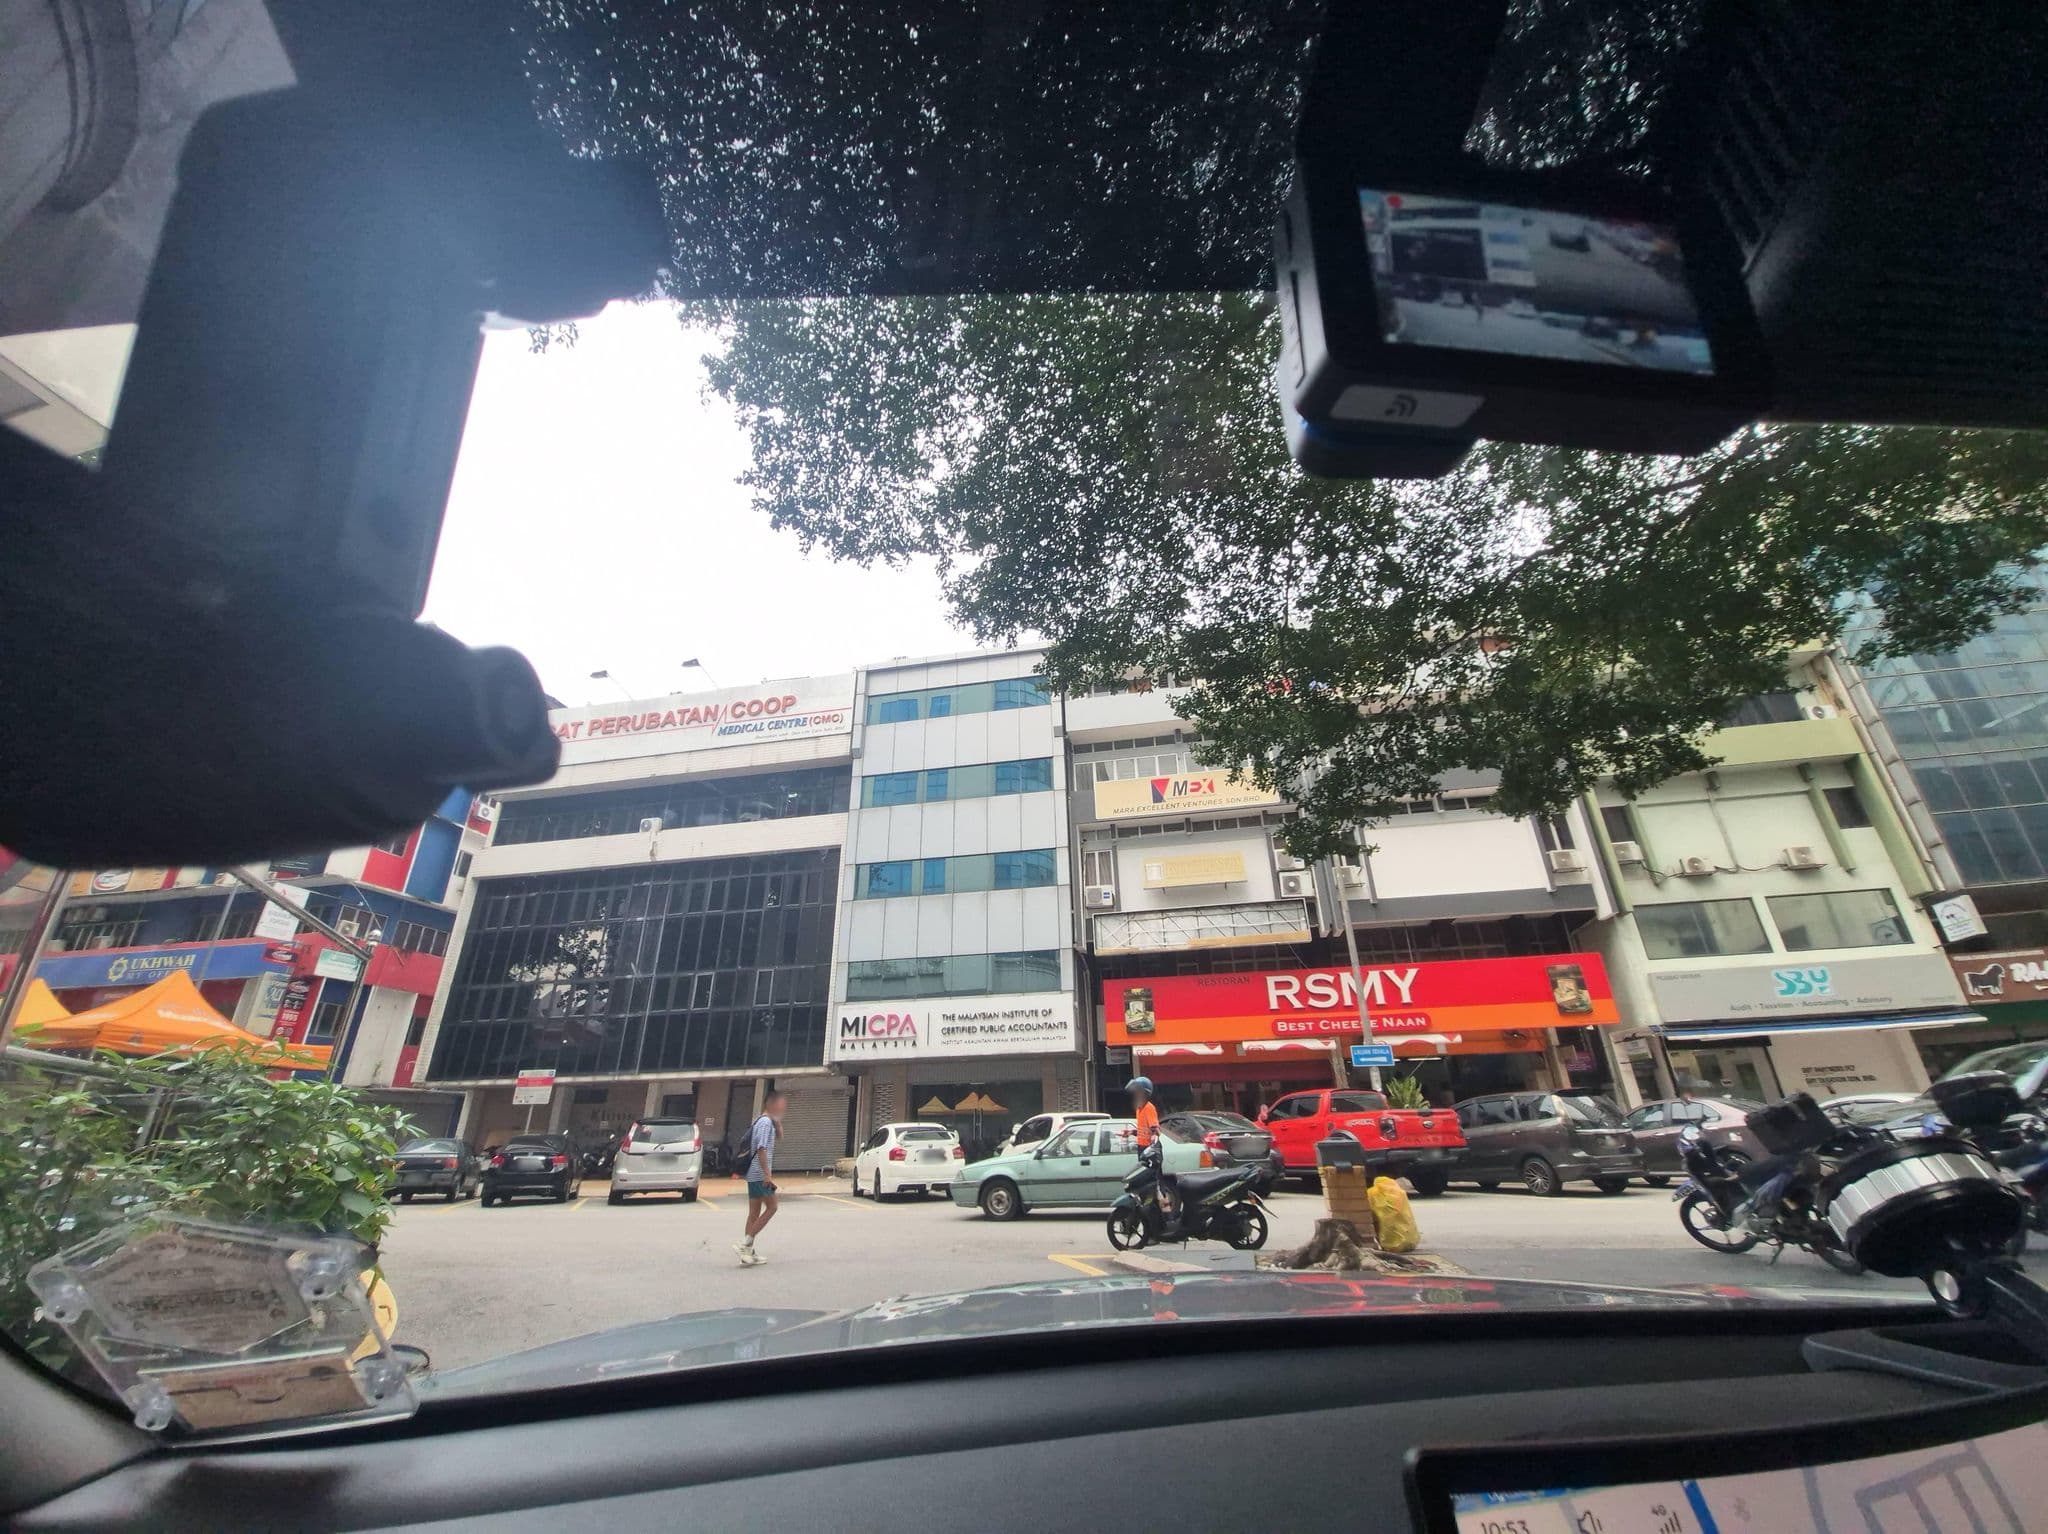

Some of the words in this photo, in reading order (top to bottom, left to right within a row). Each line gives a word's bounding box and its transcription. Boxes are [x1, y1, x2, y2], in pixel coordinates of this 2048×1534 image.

[588, 704, 719, 737] PERUBATAN
[729, 694, 797, 720] COOP
[717, 722, 765, 737] MEDICAL
[767, 716, 809, 731] CENTRE
[809, 713, 844, 728] (CMC)
[1112, 806, 1136, 815] MARA
[1137, 802, 1181, 813] EXCELLENT
[1182, 798, 1223, 808] VENTURES
[131, 954, 197, 970] UKHWAH
[1199, 975, 1250, 986] RESTORAN
[1266, 968, 1420, 1010] RSMY
[1729, 1002, 1752, 1012] Audit
[1759, 1001, 1794, 1010] Taxation
[1802, 998, 1849, 1007] Accounting
[840, 1013, 918, 1038] MICPA
[942, 1013, 956, 1021] THE
[957, 1011, 999, 1021] MALAYSIAN
[1001, 1009, 1039, 1019] INSTITUTE
[1040, 1008, 1053, 1018] OF
[941, 1025, 978, 1036] CERTIFIED
[979, 1024, 1006, 1034] PUBLIC
[1007, 1021, 1068, 1032] ACCOUNTANTS
[840, 1040, 918, 1050] MALAYSIA
